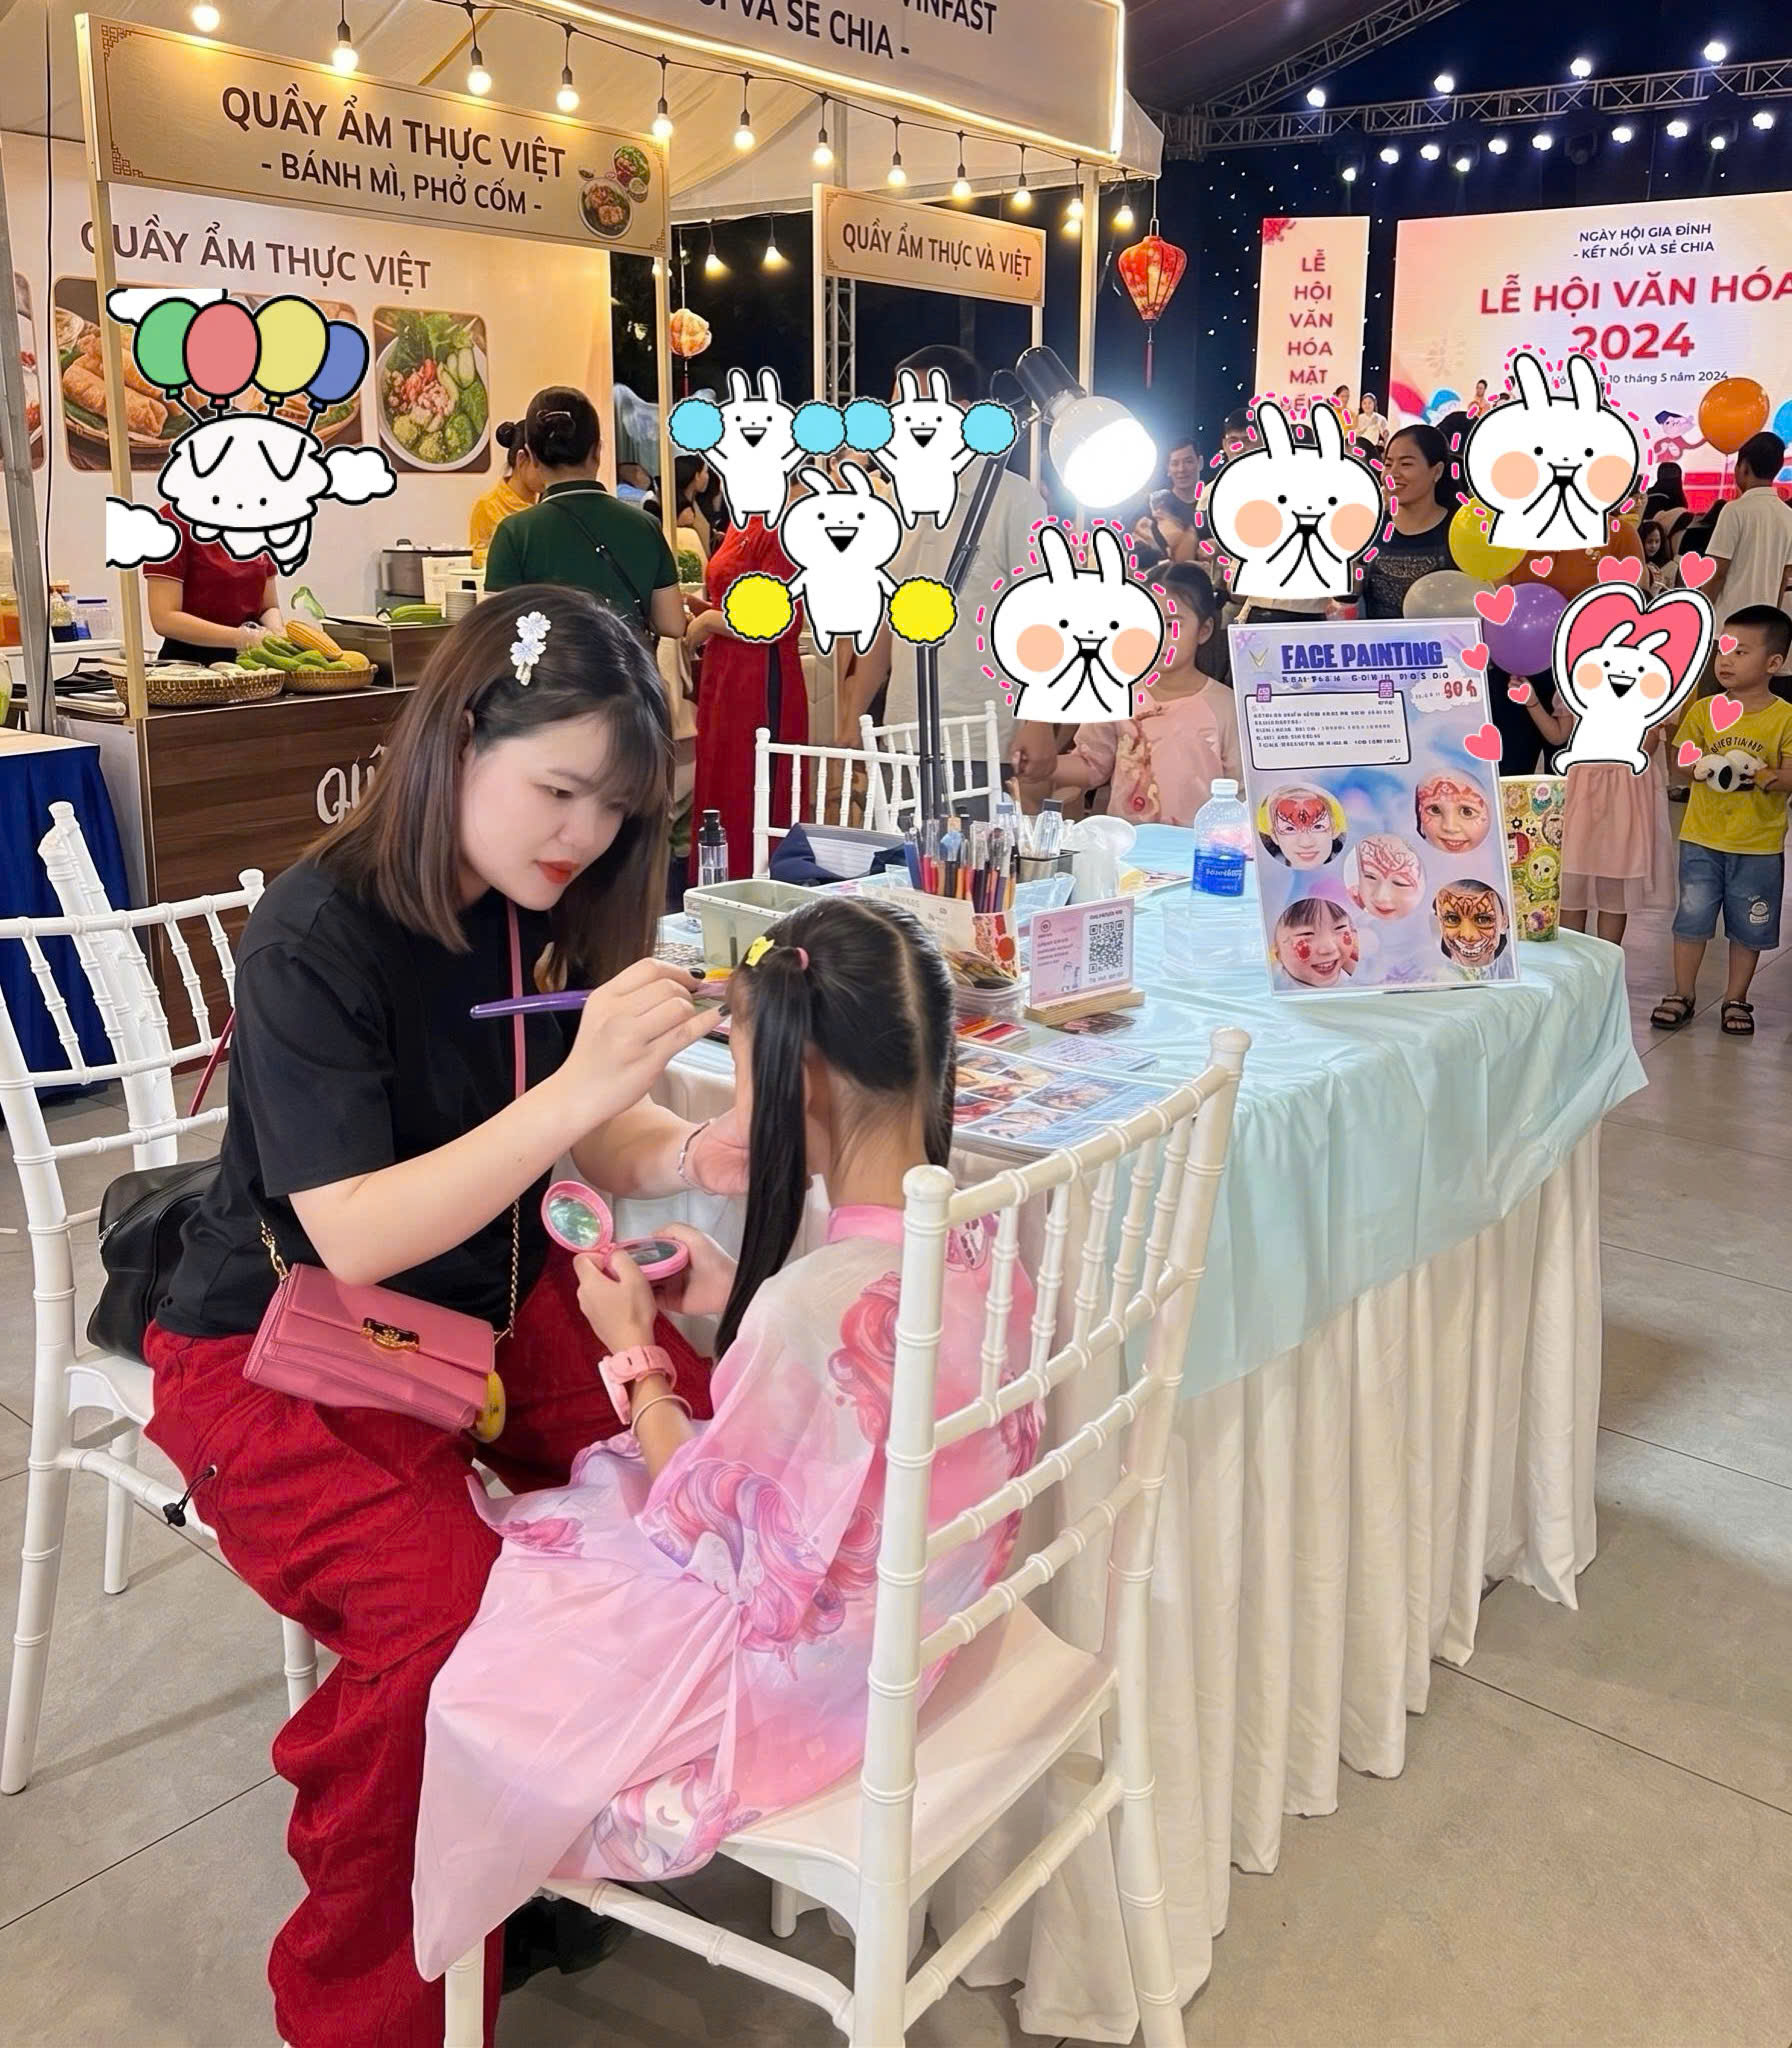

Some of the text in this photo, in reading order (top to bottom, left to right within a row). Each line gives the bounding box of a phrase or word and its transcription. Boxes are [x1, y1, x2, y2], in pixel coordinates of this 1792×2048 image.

[829, 10, 894, 59] CHIA
[222, 83, 566, 182] QUẦY ẨM THỰC VIỆT
[281, 150, 361, 190] BÁNH
[369, 163, 406, 201] MÌ,
[413, 173, 467, 205] PHỞ
[474, 178, 526, 214] CỐM
[1579, 228, 1617, 242] NGÀY
[1620, 226, 1644, 240] HỘI
[1648, 226, 1672, 237] GIA
[200, 222, 255, 271] ẨM
[265, 243, 356, 287] THỰC
[364, 250, 431, 294] VIỆT
[843, 218, 1031, 281] QUẦY ẨM THỰC VÀ VIỆT
[1302, 249, 1326, 272] LỄ
[1638, 243, 1656, 255] VÀ
[1680, 241, 1714, 253] CHIA
[1294, 281, 1332, 304] HỘI
[1480, 265, 1792, 318] LỄ HỘI VĂN HÓA
[1289, 309, 1333, 328] VĂN
[1288, 337, 1333, 356] HÓA
[1572, 322, 1695, 360] 2024
[1289, 365, 1328, 386] MẶT
[1698, 371, 1728, 381] 2024
[1281, 641, 1443, 669] FACE PAINTING
